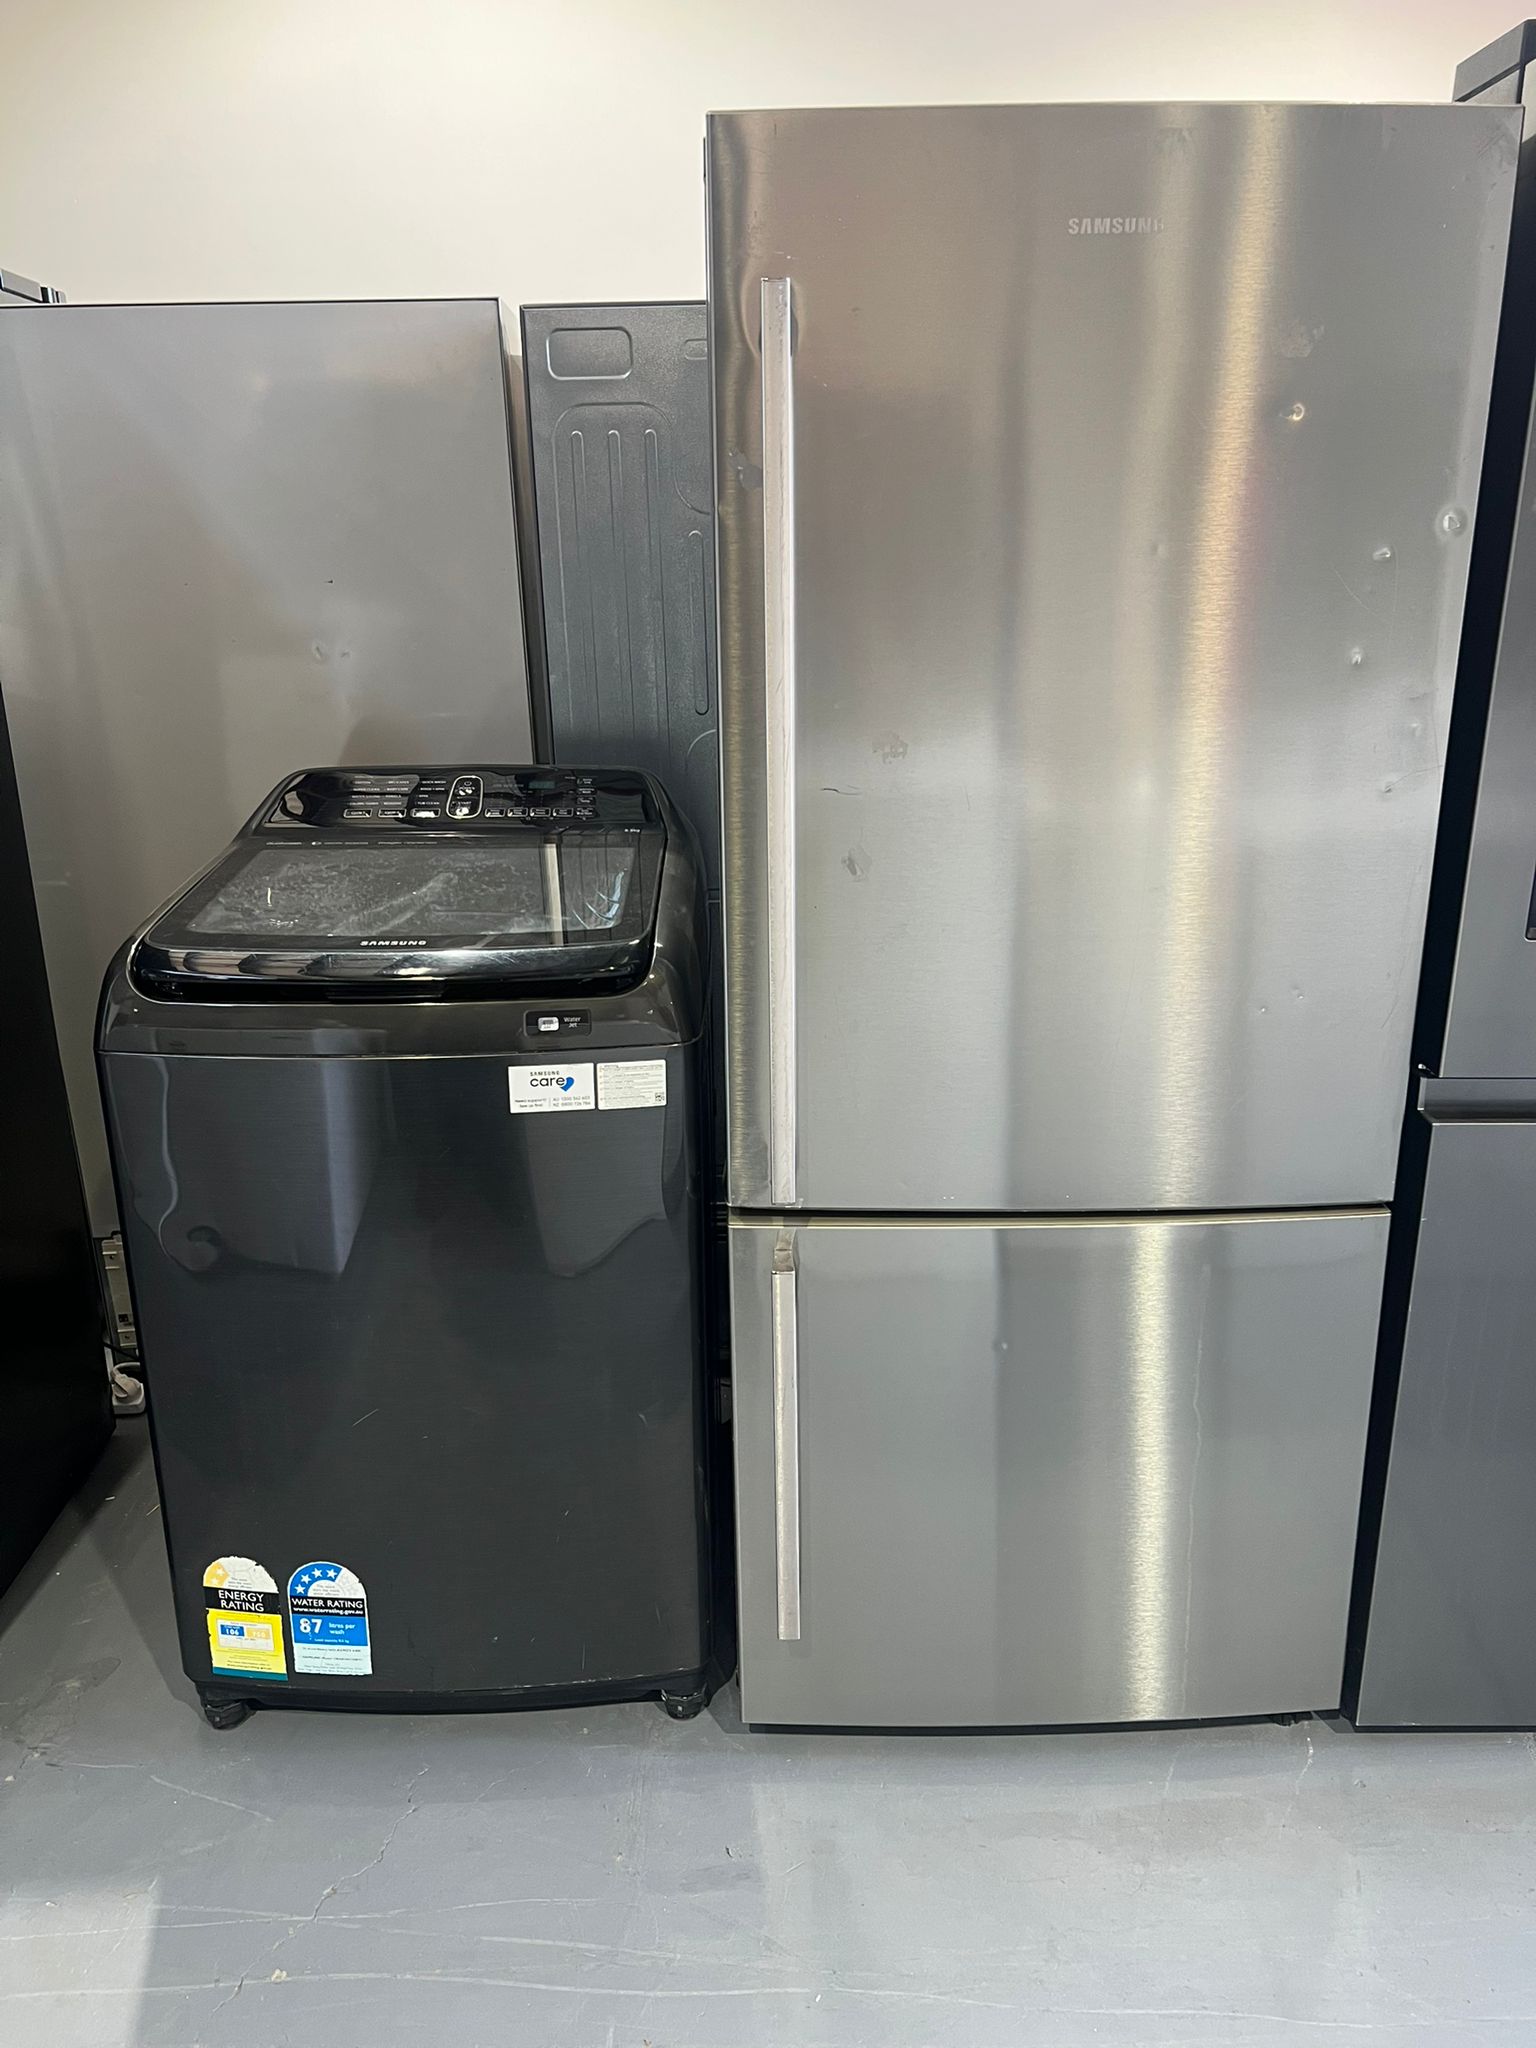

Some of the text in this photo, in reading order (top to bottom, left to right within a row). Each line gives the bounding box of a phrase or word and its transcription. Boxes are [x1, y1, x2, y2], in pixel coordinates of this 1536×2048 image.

[530, 1076, 565, 1088] care
[218, 1589, 264, 1602] ENERGY
[220, 1600, 264, 1613] RATING
[292, 1597, 363, 1609] WATER RATING
[299, 1617, 323, 1634] 87
